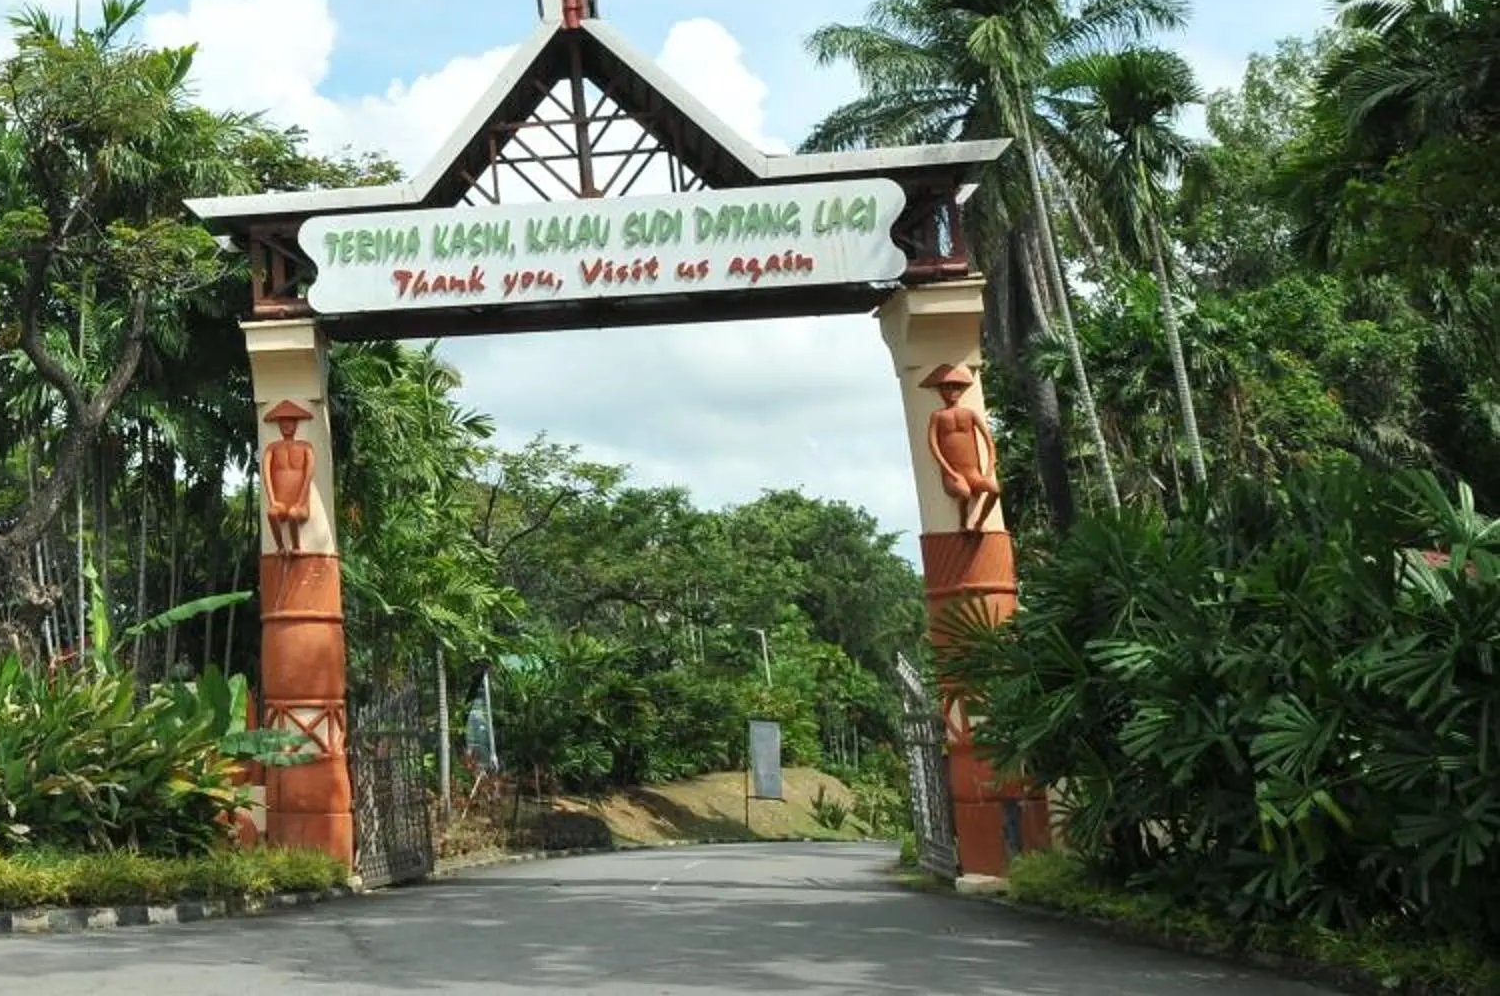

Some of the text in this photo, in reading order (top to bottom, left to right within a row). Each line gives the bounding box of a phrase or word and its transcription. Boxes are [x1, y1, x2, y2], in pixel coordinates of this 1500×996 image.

[323, 224, 421, 265] TERIMA
[524, 212, 611, 255] KALAU
[621, 207, 684, 249] SUDI
[693, 201, 801, 244] DATANG
[811, 195, 877, 235] LAGI
[393, 250, 813, 298] Thank you, Visit us again
